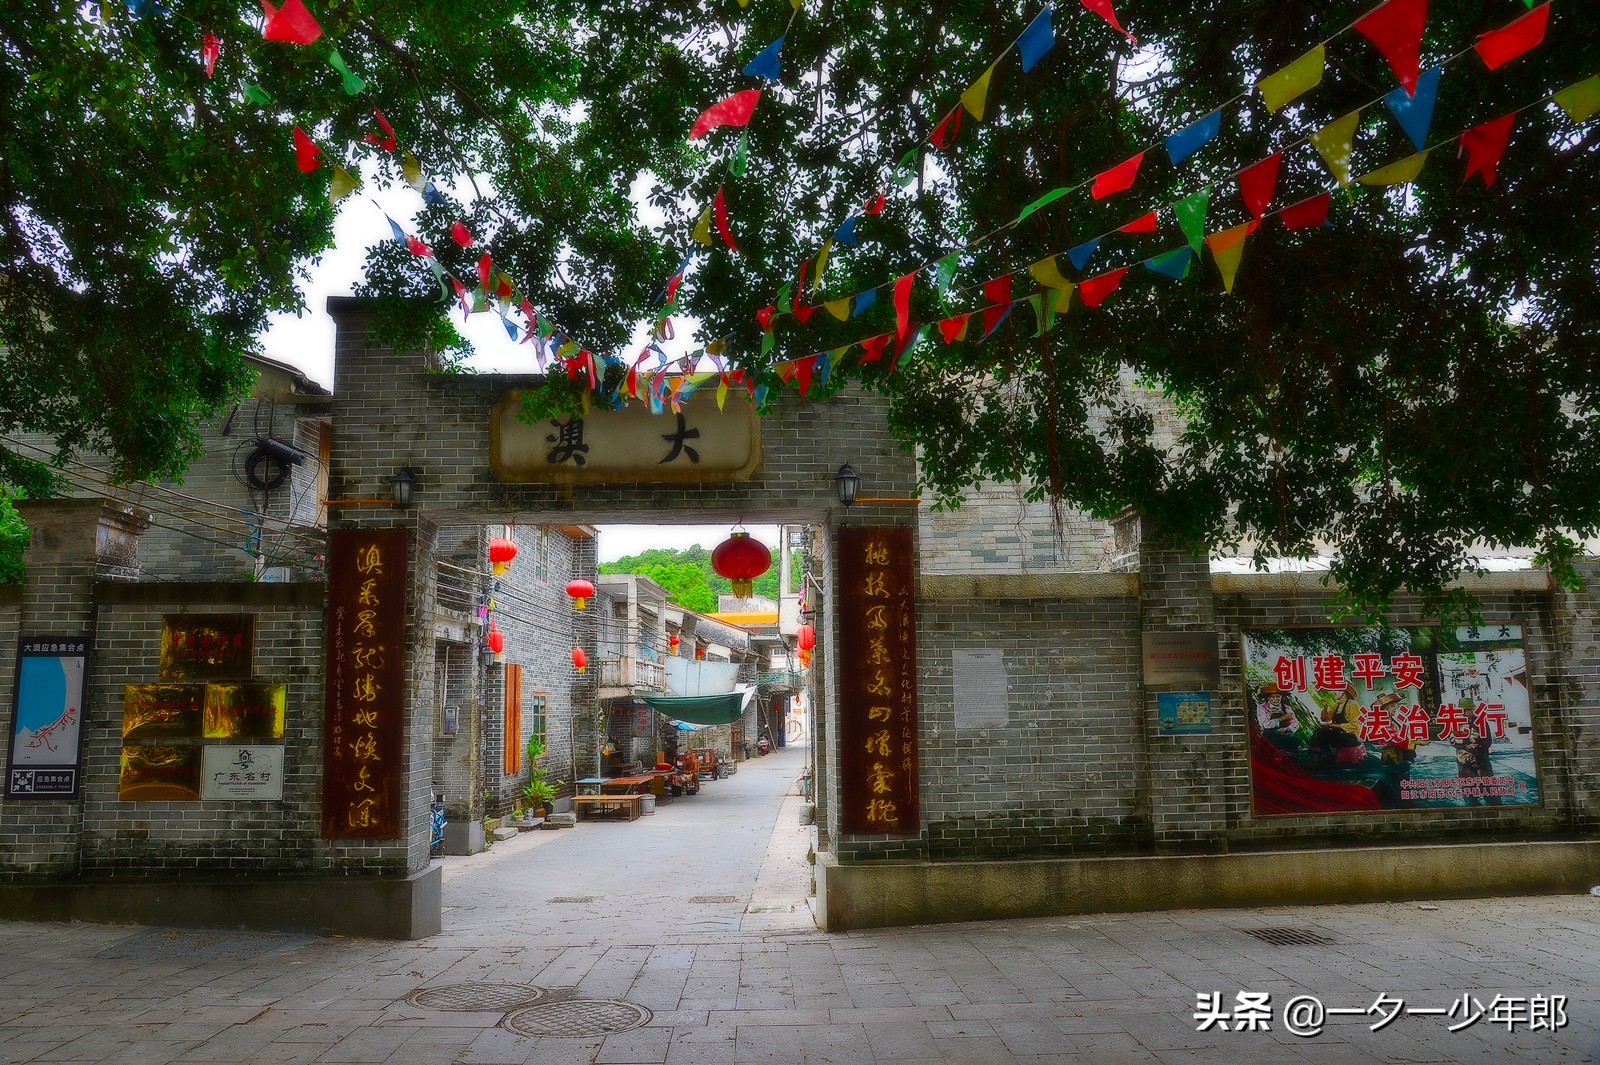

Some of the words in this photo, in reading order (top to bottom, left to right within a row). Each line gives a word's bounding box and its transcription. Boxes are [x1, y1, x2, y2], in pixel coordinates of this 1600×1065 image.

[23, 643, 85, 652] 大澳应急集合点
[1273, 652, 1425, 691] 创建平安
[1358, 702, 1509, 742] 法治先行
[36, 775, 71, 783] 应急集合点
[213, 772, 271, 781] 广东名村
